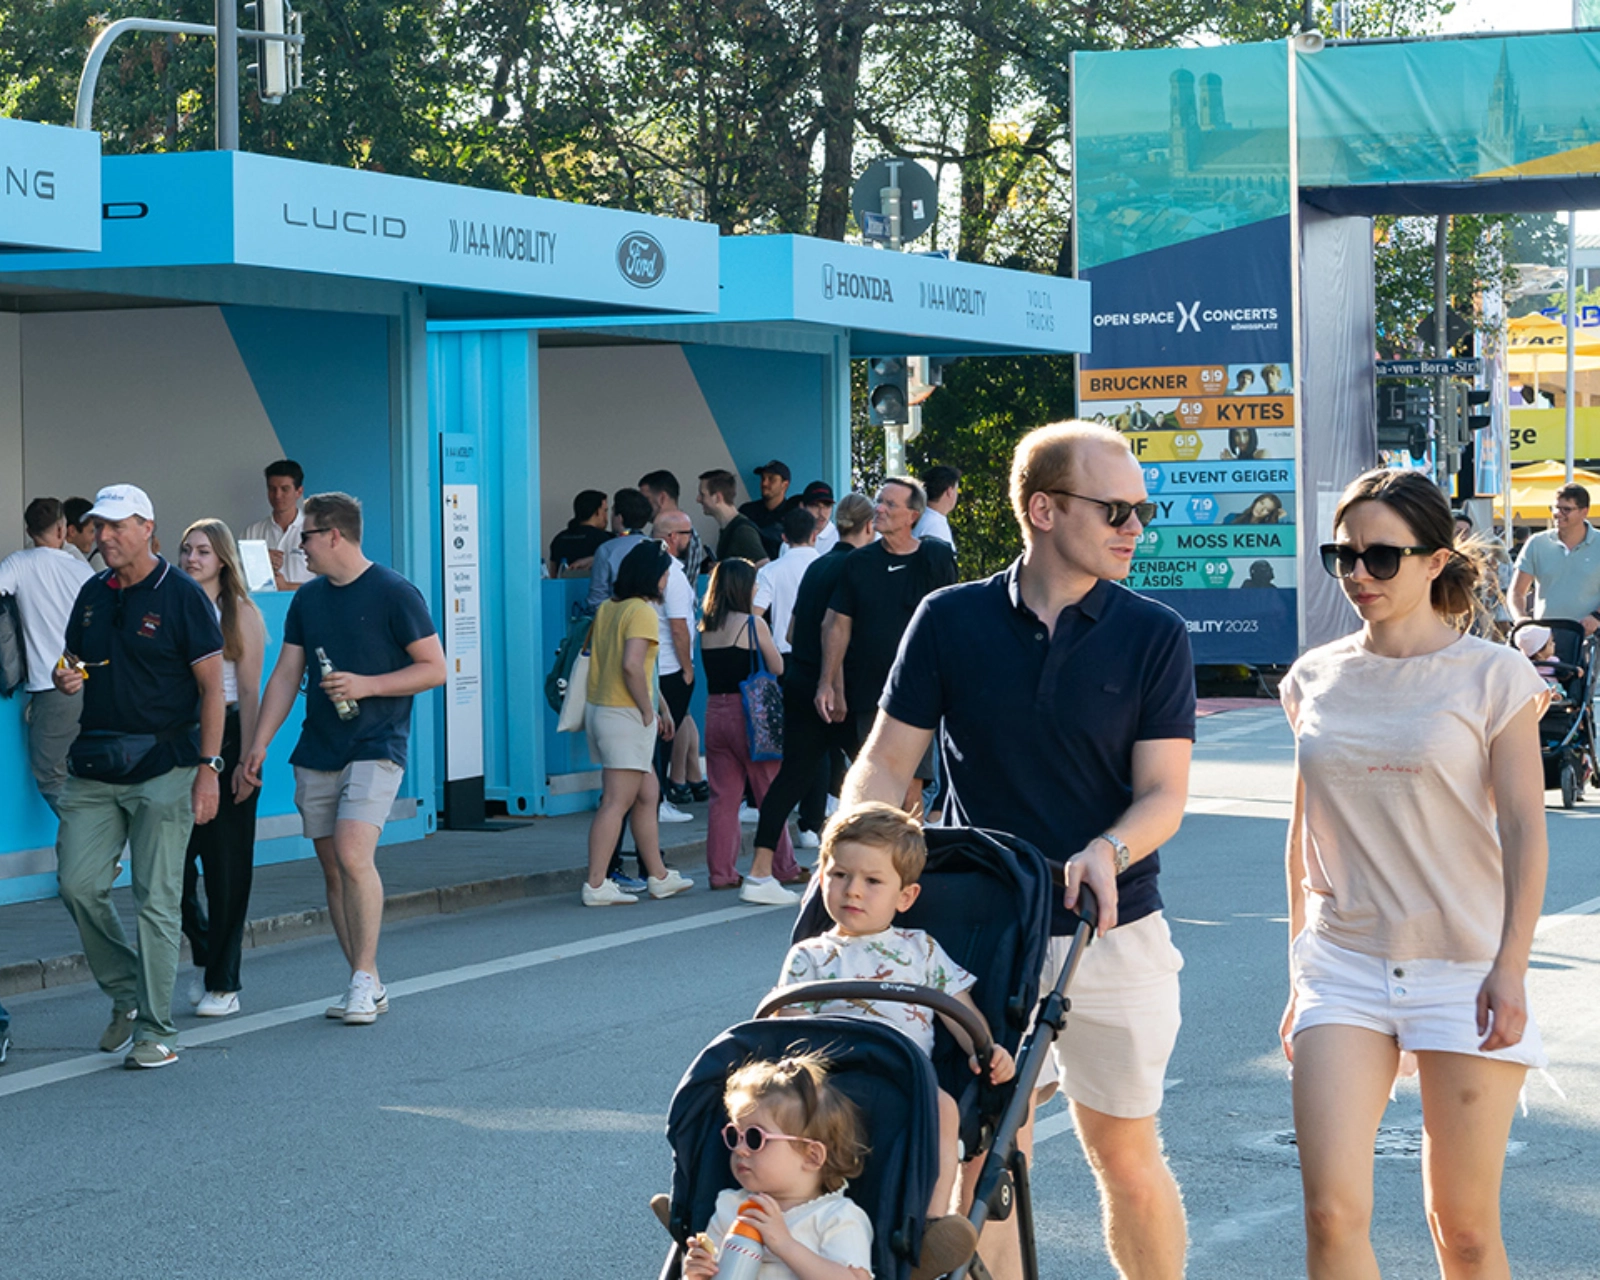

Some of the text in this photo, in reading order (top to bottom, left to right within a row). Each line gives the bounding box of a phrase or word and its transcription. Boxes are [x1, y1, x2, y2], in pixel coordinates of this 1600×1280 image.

[283, 203, 406, 239] LUCID
[462, 221, 557, 264] IAA MOBILITY
[626, 239, 657, 277] Ford
[836, 272, 894, 303] HONDA
[927, 284, 988, 317] IAA MOBILITY
[1093, 308, 1278, 327] OPEN SPACE CONCERTS
[1090, 374, 1188, 391] BRUCKNER
[1217, 403, 1284, 421] KYTES
[1171, 469, 1288, 484] LEVENT GEIGER
[1177, 533, 1282, 549] MOSS KENA
[1225, 620, 1259, 633] 2023
